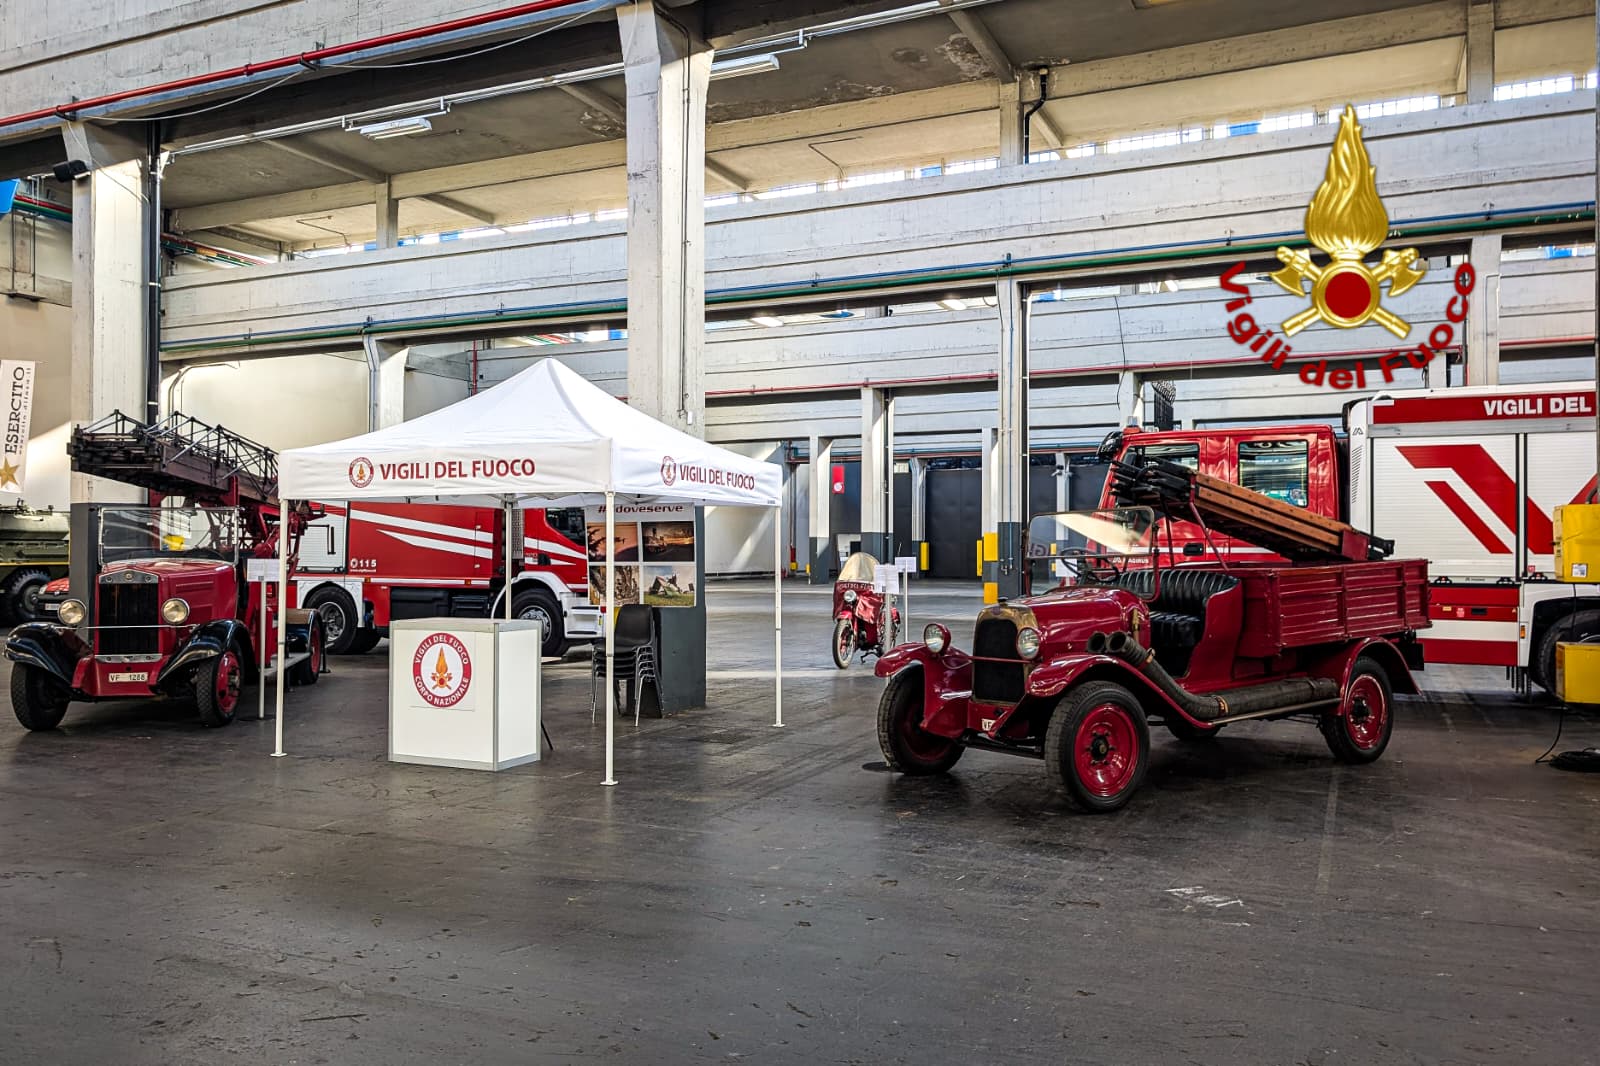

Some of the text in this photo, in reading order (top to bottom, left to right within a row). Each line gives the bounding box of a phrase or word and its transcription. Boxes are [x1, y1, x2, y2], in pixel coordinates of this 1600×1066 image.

[4, 366, 25, 455] ESERCITO
[1483, 396, 1592, 416] VIGILI DEL
[380, 462, 430, 480] VIGILI
[434, 460, 468, 479] DEL
[472, 458, 536, 478] FUOCO
[680, 464, 707, 484] VIGILI
[708, 468, 726, 486] DEL
[726, 471, 755, 491] FUOCO
[415, 634, 469, 665] VIGILI DEL FUOCO
[415, 676, 469, 705] CORPO NAZIONALE
